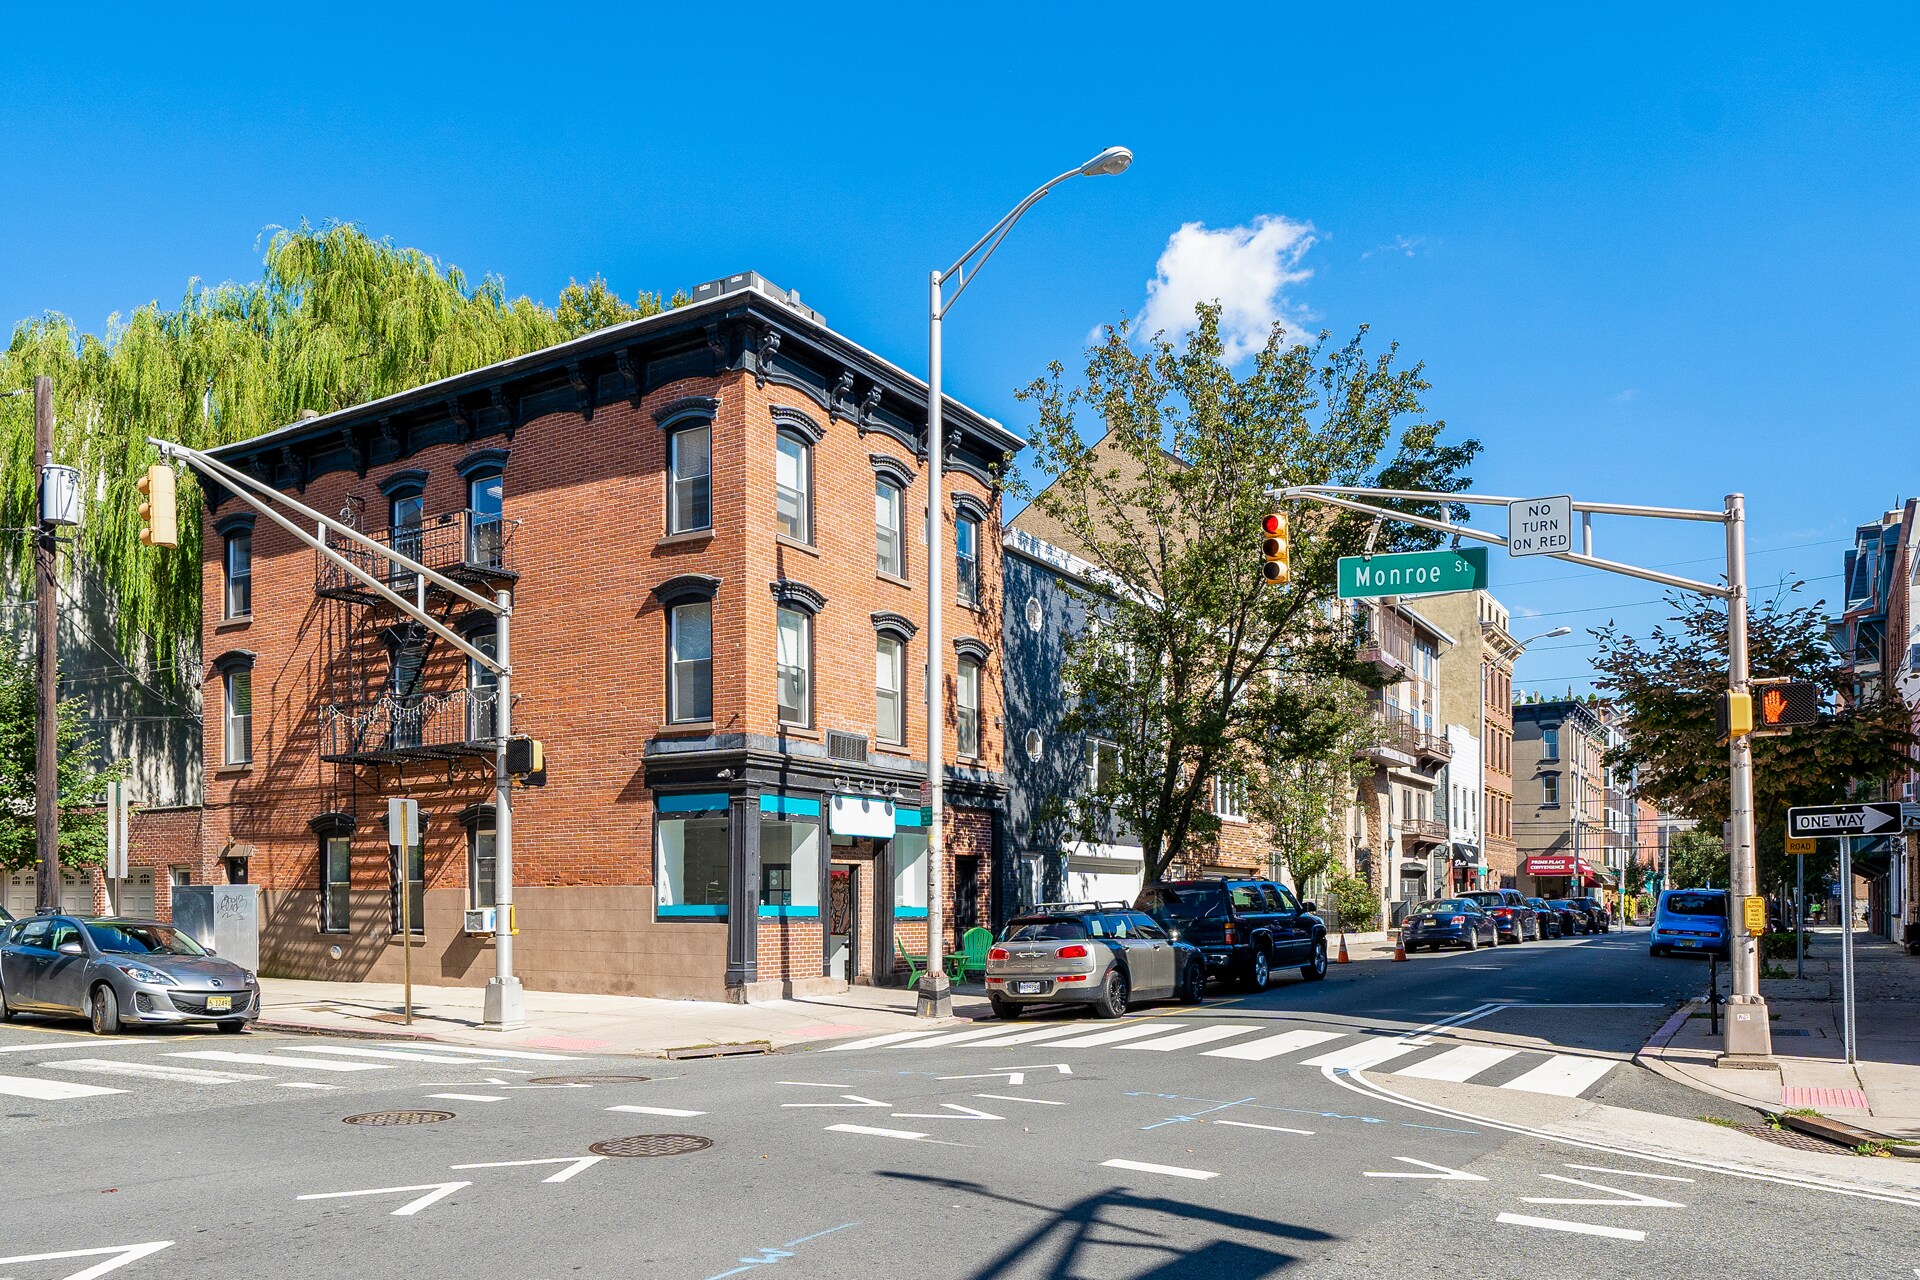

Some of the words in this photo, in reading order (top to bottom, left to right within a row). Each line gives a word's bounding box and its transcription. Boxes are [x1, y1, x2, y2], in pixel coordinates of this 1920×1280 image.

[1529, 504, 1551, 517] NO
[1522, 519, 1558, 533] TURN
[1513, 538, 1532, 550] ON
[1540, 534, 1567, 547] RED
[1355, 566, 1441, 587] Monroe
[1454, 560, 1469, 572] St
[1800, 816, 1831, 828] ONE
[1835, 814, 1867, 827] WAY
[1789, 842, 1811, 851] ROAD
